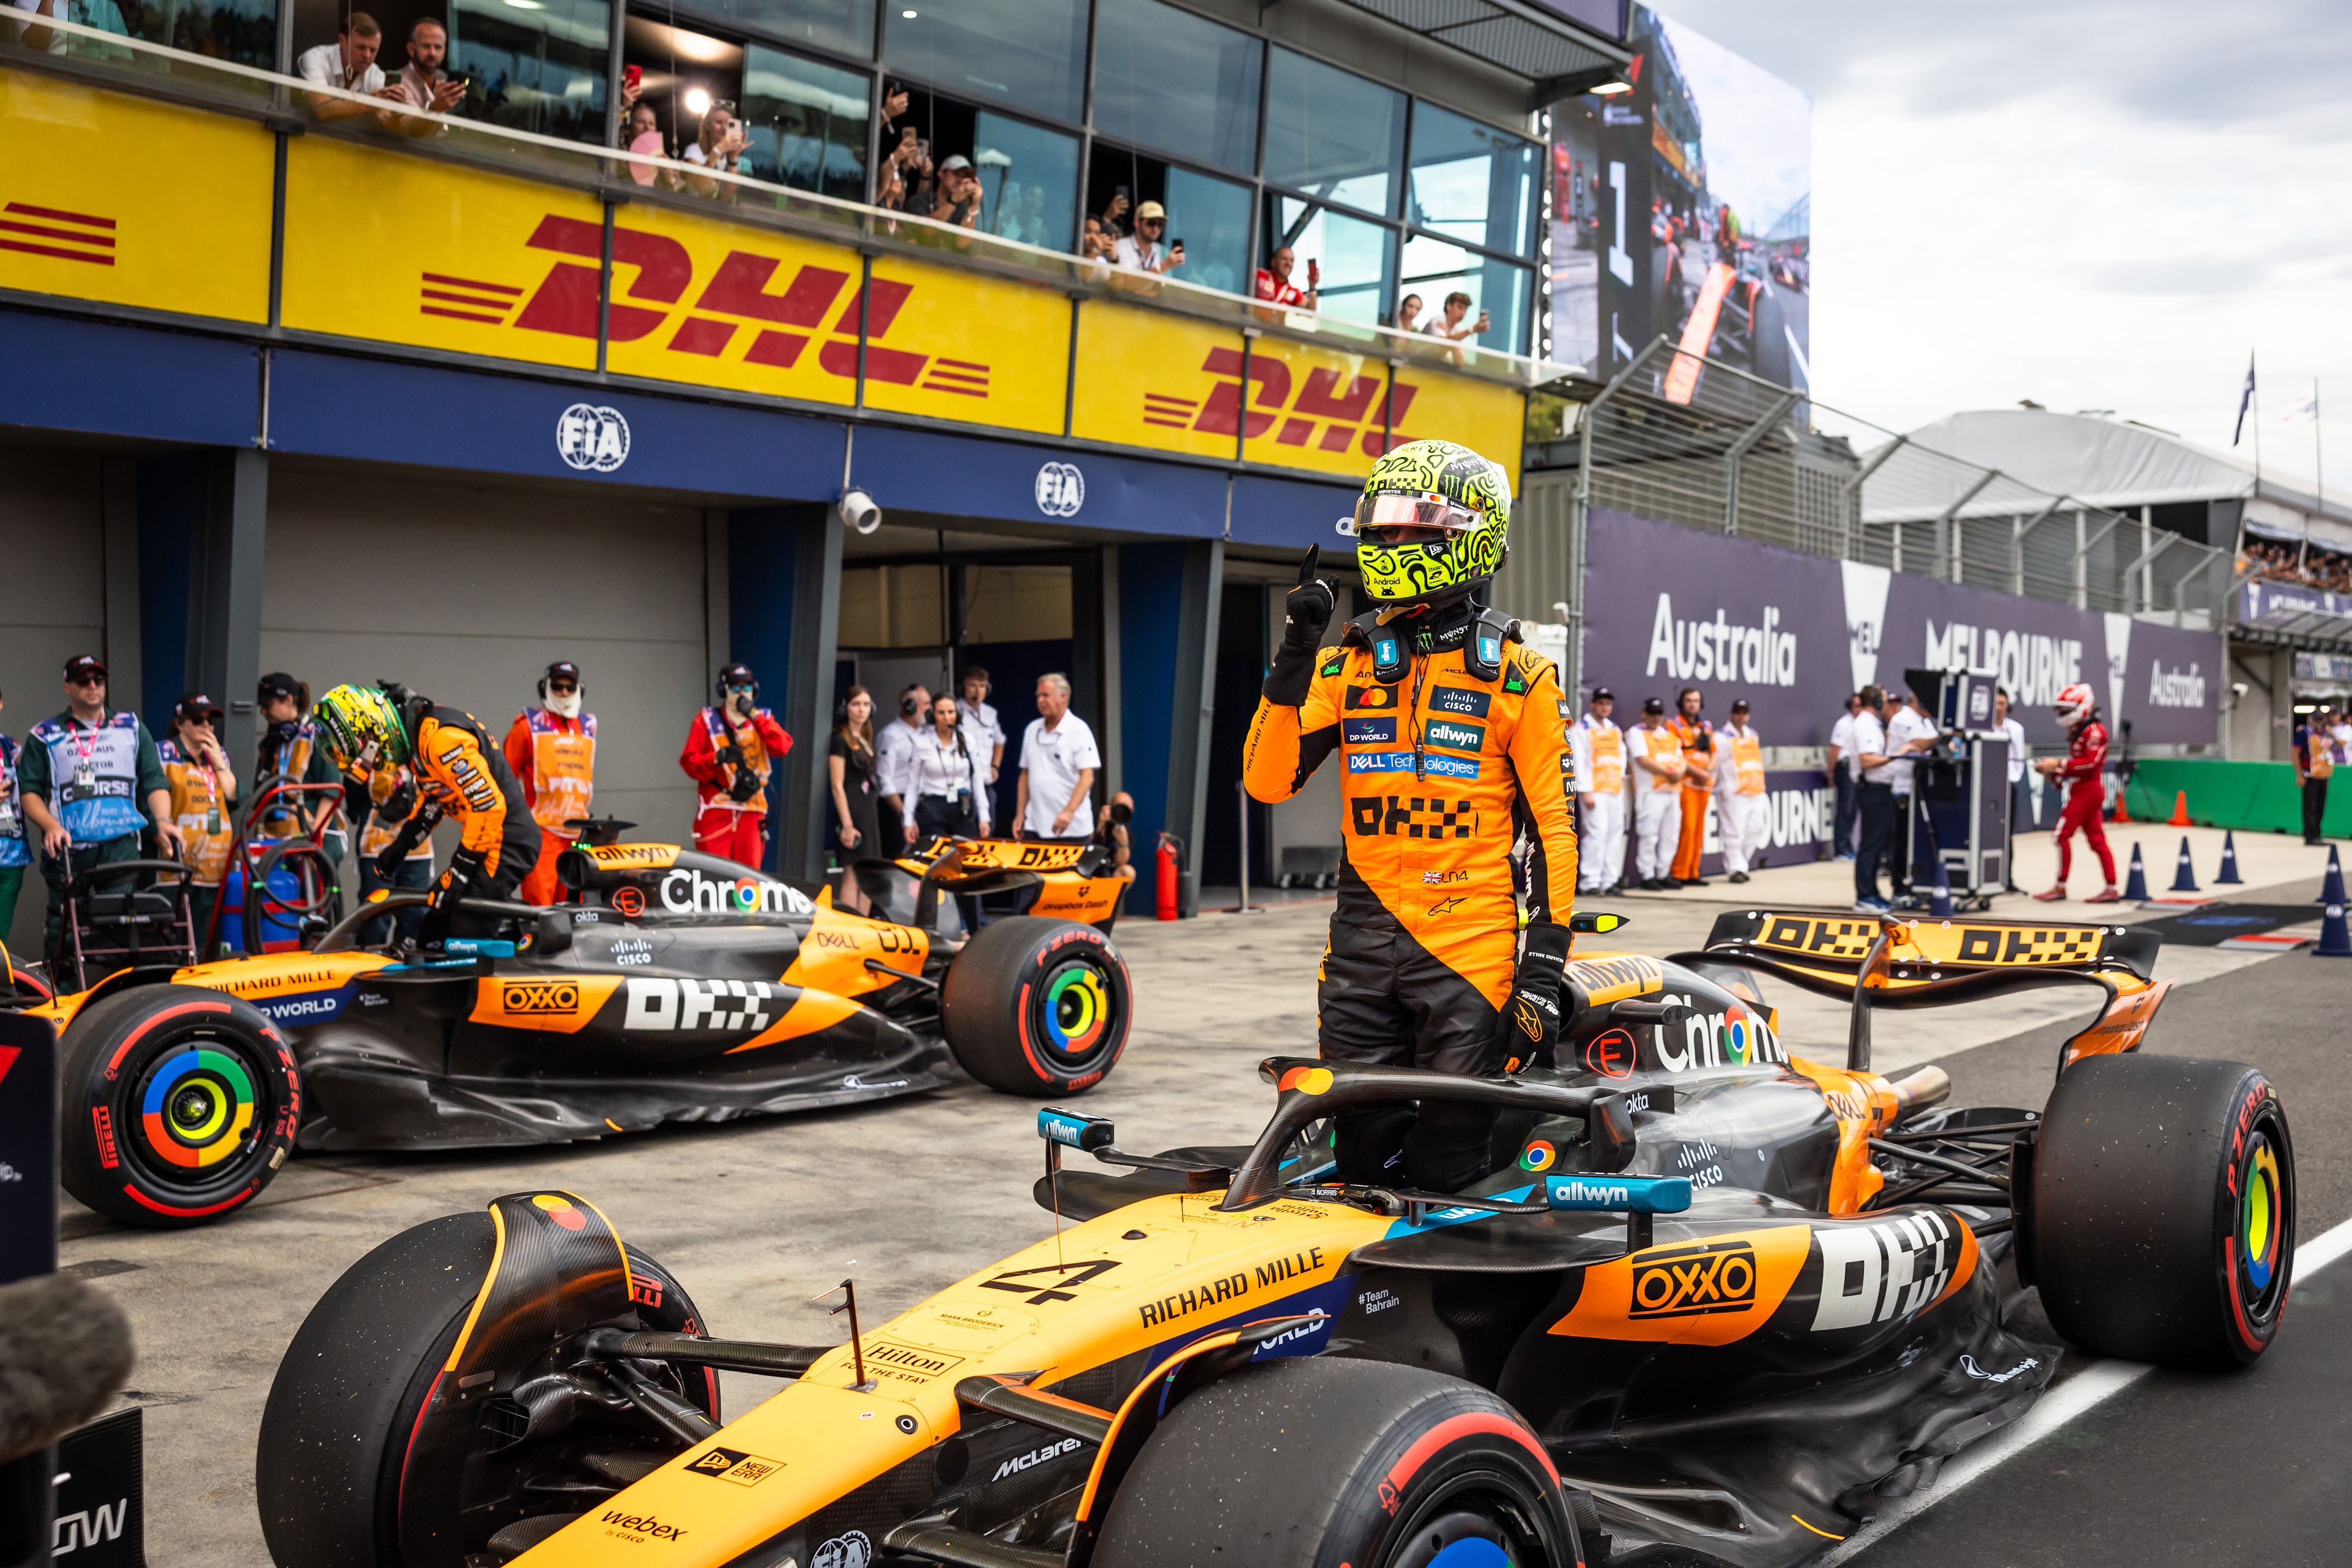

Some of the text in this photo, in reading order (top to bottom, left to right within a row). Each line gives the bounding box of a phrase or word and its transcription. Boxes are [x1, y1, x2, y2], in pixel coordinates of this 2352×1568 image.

[1608, 160, 1633, 287] 1
[513, 214, 929, 386] DHL
[1193, 346, 1420, 457] DHL
[1373, 577, 1400, 585] Android
[1646, 592, 1796, 687] Australia
[2149, 660, 2205, 708] Australia
[1430, 725, 1478, 746] allwyn
[1246, 728, 1262, 772] RICHARD
[1351, 755, 1386, 769] DELL
[62, 780, 130, 801] CURSE
[596, 846, 670, 863] allwyn
[660, 868, 813, 914] Chrome
[575, 911, 599, 923] okta
[1050, 931, 1102, 952] ZERO
[287, 969, 336, 985] MILLE
[1571, 956, 1658, 993] allwyn
[273, 998, 337, 1019] WORLD
[504, 987, 577, 1011] OXXO
[277, 1049, 300, 1140] ZERO
[1626, 1092, 1649, 1114] okta
[1045, 1118, 1078, 1142] allwyn
[2232, 1081, 2266, 1161] ZERO
[92, 1105, 119, 1169] PIRELLI
[1555, 1182, 1628, 1206] allwyn
[977, 1259, 1123, 1305] 4
[1139, 1246, 1325, 1329] RICHARD MILLE
[1636, 1256, 1755, 1309] OXXO
[1358, 1288, 1388, 1305] #Team
[1366, 1296, 1400, 1315] Bahrain
[961, 1316, 1005, 1329] BRODERICK
[1253, 1307, 1324, 1357] ORLD
[867, 1346, 946, 1371] Hilton
[869, 1367, 896, 1378] THE
[895, 1373, 930, 1385] STAY
[732, 1466, 764, 1482] ERA
[742, 1460, 773, 1476] NEW
[600, 1509, 688, 1543] webex
[603, 1528, 617, 1538] by
